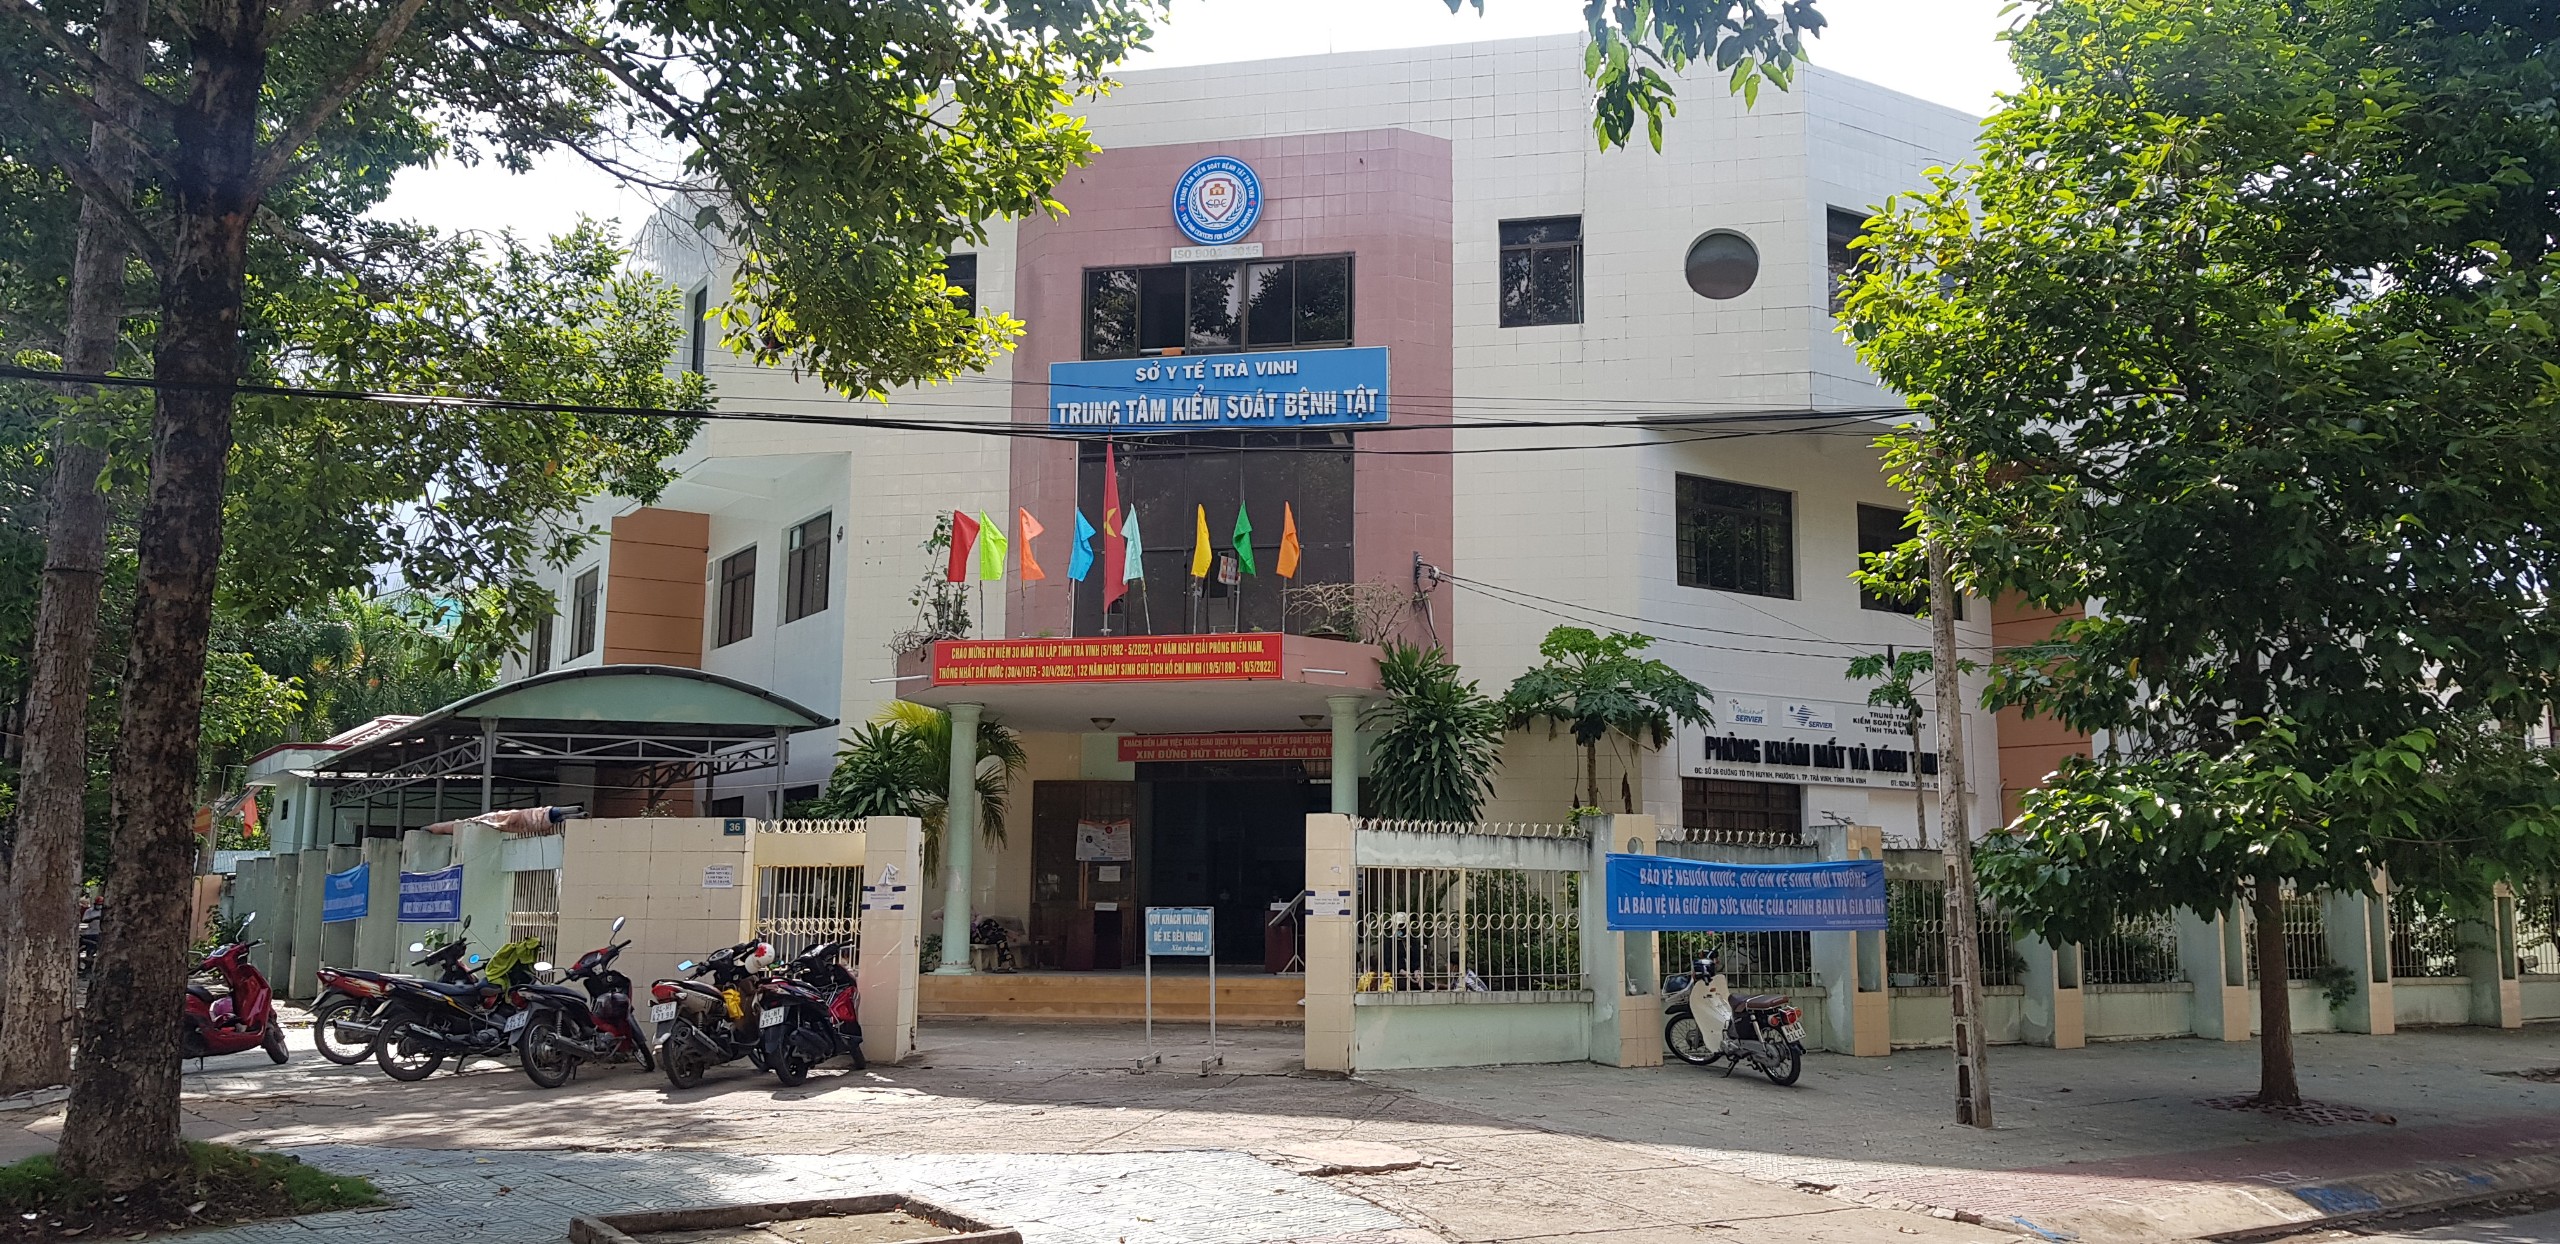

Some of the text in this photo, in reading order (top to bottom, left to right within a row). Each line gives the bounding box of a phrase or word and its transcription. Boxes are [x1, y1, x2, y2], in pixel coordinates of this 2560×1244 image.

[1174, 250, 1191, 258] ISO
[1136, 359, 1298, 382] SỞ Y TẾ TRÀ VINH
[1057, 384, 1378, 424] TRUNG TÂM KIỂM SOÁT BỆNH TẬT
[952, 644, 968, 659] CHÀO
[968, 645, 986, 658] MỪNG
[996, 645, 1011, 661] NIỆM
[1012, 648, 1020, 658] 30
[1021, 644, 1034, 658] NĂM
[1036, 644, 1047, 657] TÁI
[1048, 643, 1058, 660] LẬP
[1060, 642, 1072, 657] TỈNH
[1074, 643, 1086, 656] TRÀ
[1086, 645, 1100, 656] VINH
[1101, 645, 1124, 658] (5/1992
[1154, 643, 1162, 655] 47
[1162, 640, 1177, 654] NĂM
[1178, 640, 1194, 654] NGÀY
[1196, 638, 1208, 654] GIẢI
[1209, 640, 1230, 654] PHÓNG
[1231, 637, 1247, 653] MIỀN
[1248, 640, 1264, 653] NAM,
[939, 664, 958, 680] THỐNG
[960, 663, 974, 679] NHẤT
[975, 664, 988, 678] ĐẤT
[988, 664, 1005, 678] NƯỚC
[1078, 664, 1088, 676] 132
[1088, 662, 1104, 676] NĂM
[1105, 660, 1121, 676] NGÀY
[1122, 663, 1136, 675] SINH
[1137, 660, 1150, 675] CHỦ
[1150, 662, 1164, 678] TỊCH
[1165, 658, 1174, 674] HỒ
[1174, 660, 1185, 674] CHÍ
[1186, 661, 1202, 674] MINH
[1734, 714, 1762, 724] SERVIER
[1852, 716, 1892, 728] KIỂM SOÁT
[1870, 711, 1911, 720] TRUNG TÂM
[1808, 721, 1832, 730] SERVIER
[1865, 725, 1882, 734] TỈNH
[1884, 727, 1898, 736] TRÀ
[1124, 738, 1142, 748] KHÁCH
[1144, 737, 1155, 747] ĐẾN
[1156, 736, 1168, 747] LÀM
[1170, 737, 1182, 748] VIỆC
[1184, 737, 1198, 747] HOẶC
[1200, 738, 1214, 746] GIAO
[1214, 738, 1228, 747] DỊCH
[1229, 737, 1238, 746] TẠI
[1240, 738, 1258, 746] TRUNG
[1259, 736, 1272, 745] TÂM
[1272, 735, 1288, 745] KIỂM
[1289, 736, 1304, 745] SOÁT
[1304, 735, 1321, 746] BỆNH
[1136, 750, 1154, 759] XIN
[1158, 748, 1188, 759] ĐỪNG
[1214, 746, 1248, 758] THUỐC
[1260, 746, 1280, 757] RẤT
[1311, 746, 1326, 756] ƠN
[1705, 732, 1761, 764] PHÒNG
[1765, 737, 1810, 766] KHÁM
[1814, 737, 1846, 769] MẮT
[1848, 743, 1870, 770] VÀ
[1872, 744, 1908, 773] KÍNH
[1694, 766, 1703, 774] ĐC:
[1704, 766, 1712, 775] SỐ
[1720, 768, 1738, 777] ĐƯỜNG
[1739, 768, 1746, 776] TÔ
[1746, 769, 1754, 778] THỊ
[1756, 770, 1774, 778] HUỲNH,
[1775, 771, 1795, 780] PHƯỜNG
[1810, 773, 1820, 781] TRÀ
[1834, 774, 1845, 782] TỈNH
[730, 823, 740, 832] 36
[1640, 863, 1866, 890] BẢO VỆ NGUỒN NƯỚC, GIỮ GÌN VỆ SINH MÔI TRƯỜNG
[1618, 893, 1630, 914] LÀ
[1632, 890, 1652, 914] BẢO
[1655, 894, 1666, 918] VỆ
[1668, 894, 1681, 914] VÀ
[1683, 894, 1700, 914] GIỮ
[1702, 894, 1718, 914] GÌN
[1720, 894, 1739, 914] SỨC
[1740, 893, 1765, 915] KHỎE
[1766, 893, 1784, 915] CỦA
[1786, 896, 1814, 915] CHÍNH
[1816, 899, 1834, 918] BẠN
[1836, 895, 1847, 914] VÀ
[1850, 899, 1864, 914] GIA
[1162, 911, 1180, 925] KHÁCH
[1182, 914, 1192, 924] VUI
[1193, 912, 1208, 925] LÒNG
[1154, 927, 1204, 942] ĐỂ XE BÊN NGOÀI
